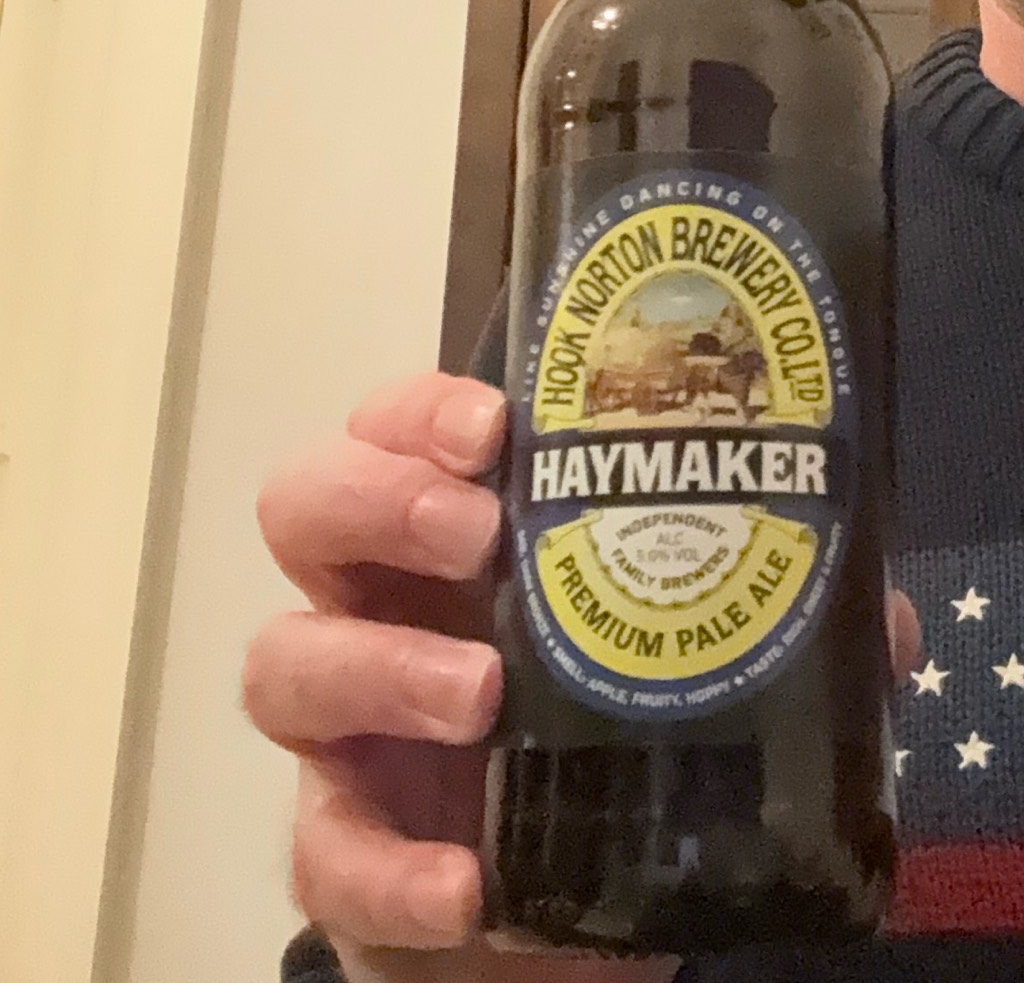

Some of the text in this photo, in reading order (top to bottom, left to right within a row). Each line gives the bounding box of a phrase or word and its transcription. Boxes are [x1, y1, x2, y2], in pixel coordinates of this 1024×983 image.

[537, 209, 610, 328] SUNSHINE
[619, 181, 743, 211] DANCING
[751, 205, 784, 233] ON
[789, 238, 822, 284] THE
[818, 296, 851, 395] TONGUE
[565, 220, 664, 327] NORTON
[671, 216, 802, 315] BREWERY
[541, 328, 591, 406] HOOK
[531, 440, 827, 502] HAYMAKER
[616, 513, 727, 541] INDEPENDENT
[656, 531, 684, 545] ALC
[555, 553, 664, 658] PREMIUM
[675, 600, 752, 657] PALE
[748, 548, 794, 608] ALE
[611, 546, 729, 591] FAMILY BREWERS
